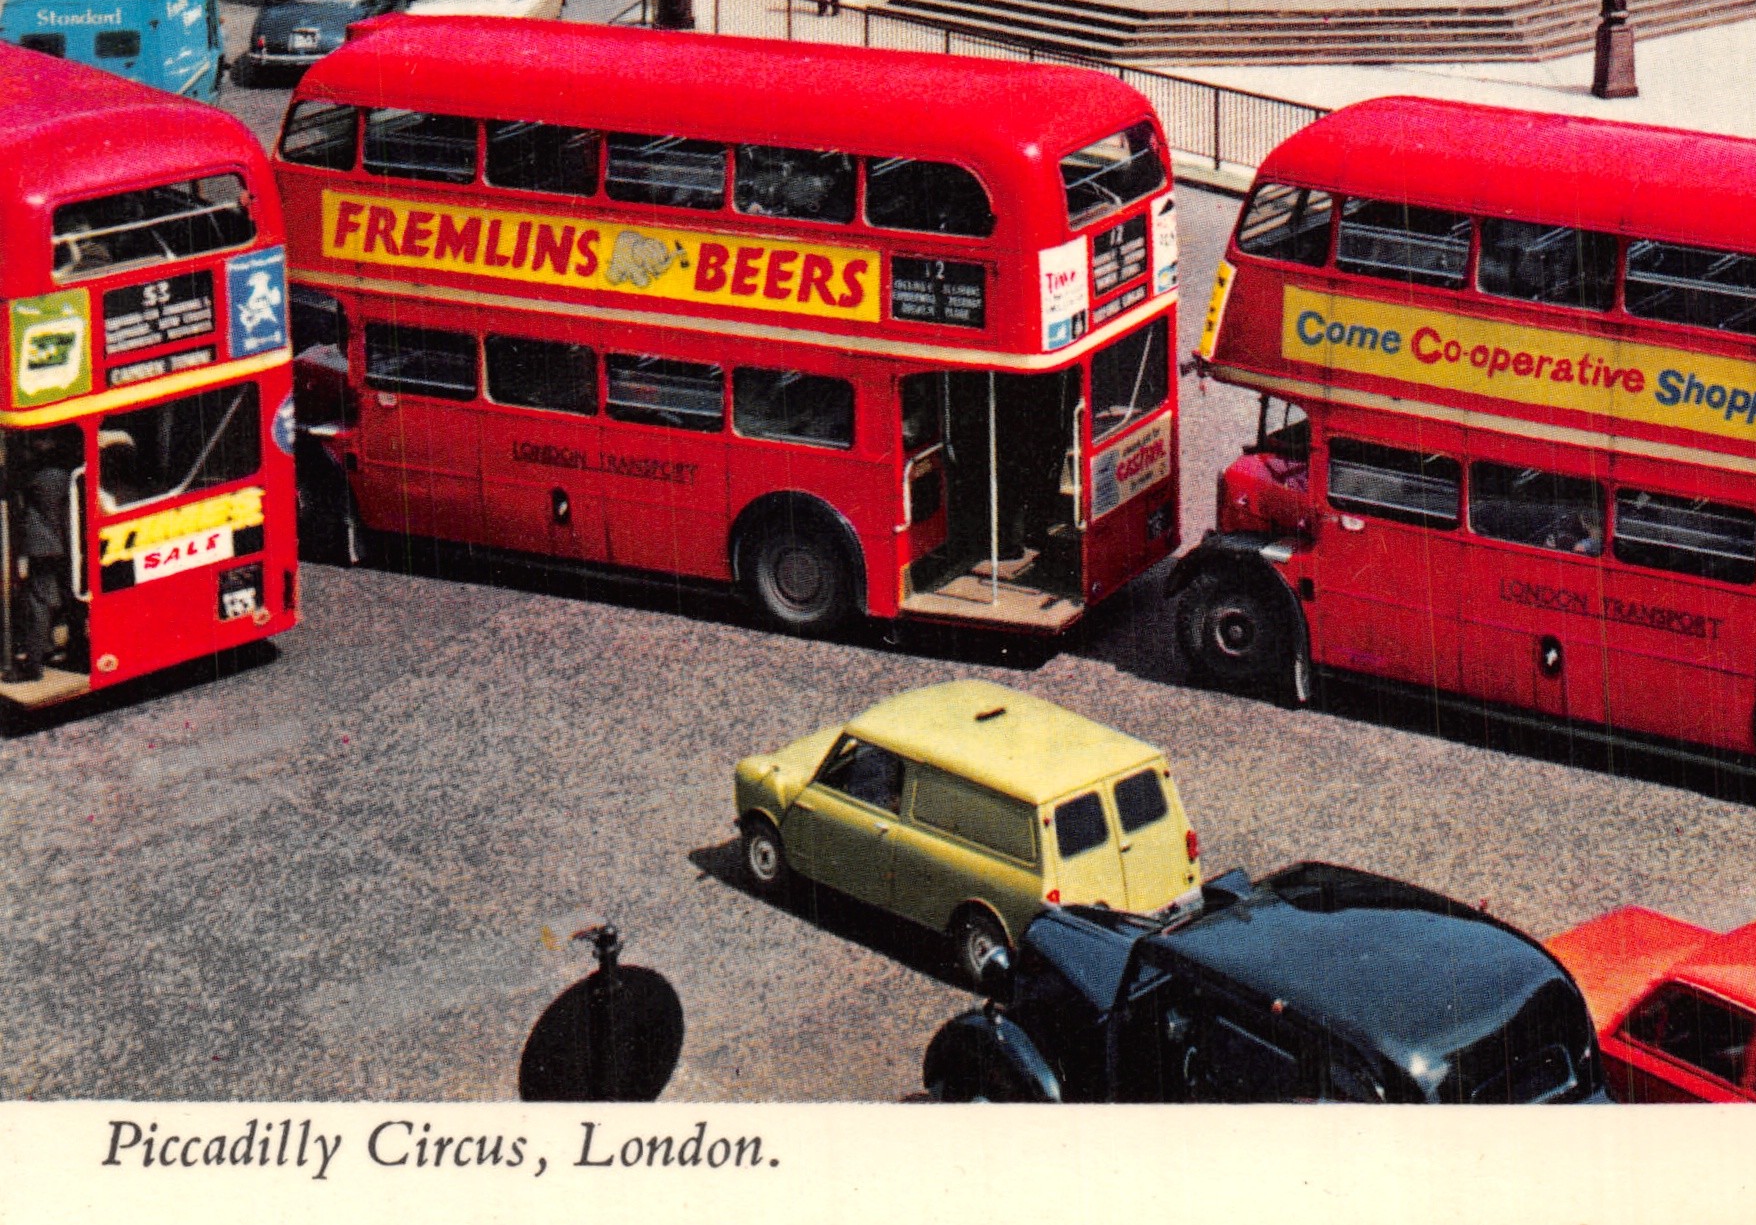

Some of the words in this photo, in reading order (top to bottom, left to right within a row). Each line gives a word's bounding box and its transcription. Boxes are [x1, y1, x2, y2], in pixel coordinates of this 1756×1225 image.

[334, 201, 601, 279] FREMLINS
[694, 241, 869, 309] BEERS
[1296, 310, 1402, 354] Come
[1411, 326, 1645, 394] Co-operative
[513, 440, 588, 473] LONDON
[599, 451, 698, 485] TRANSPORT
[143, 533, 219, 569] SALE
[1501, 577, 1589, 618] LONDON
[1599, 594, 1724, 642] TRANSPORT
